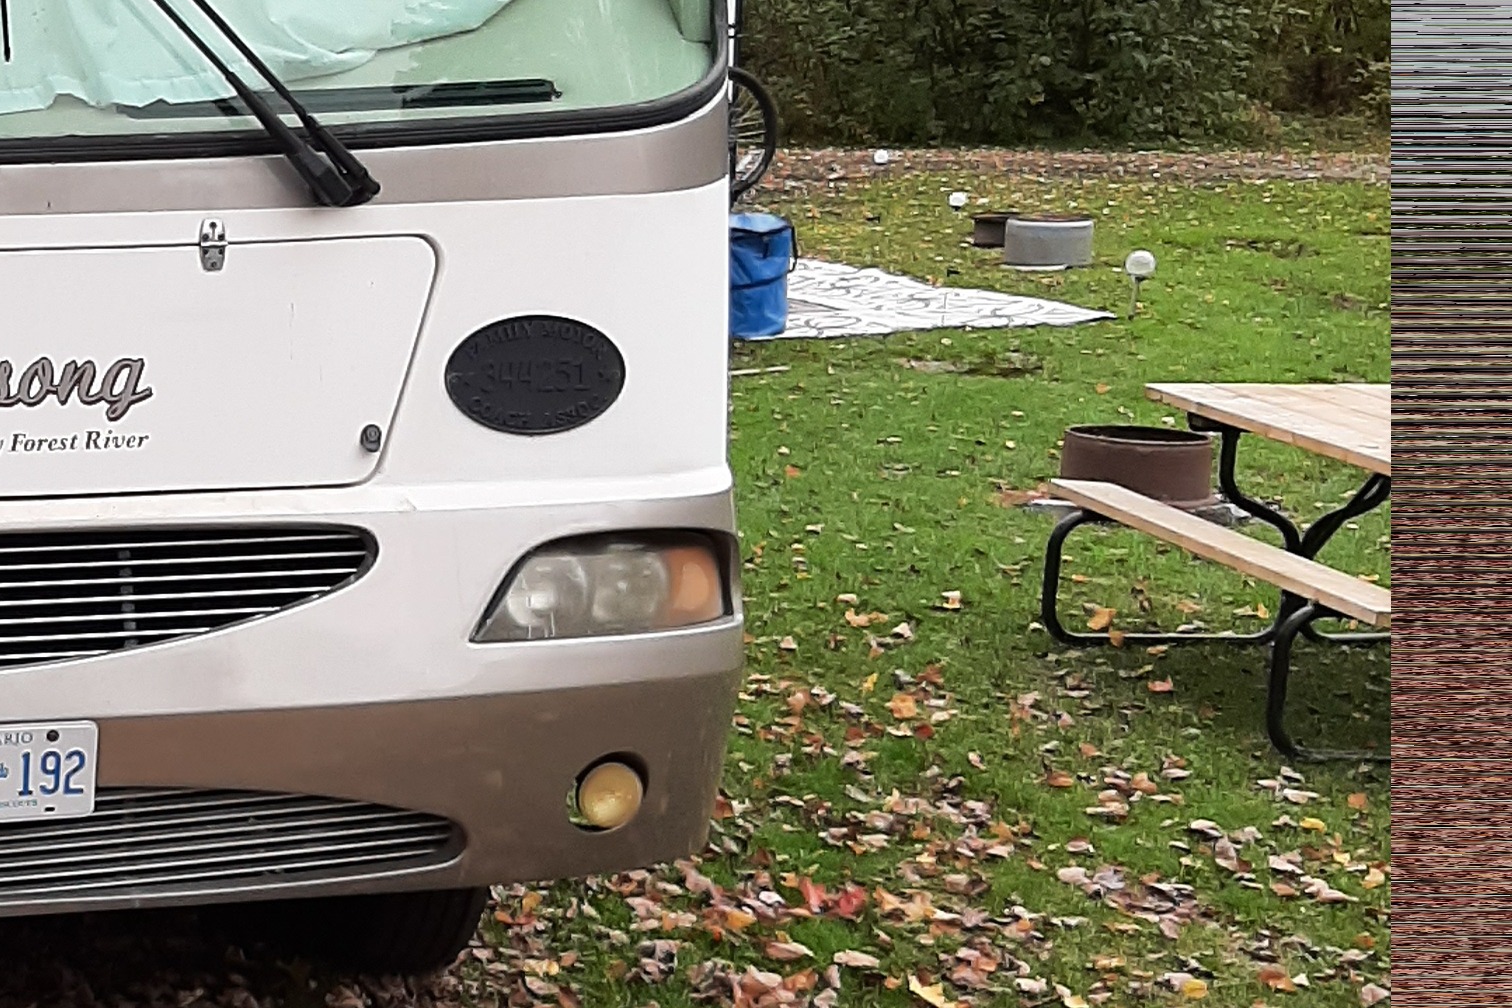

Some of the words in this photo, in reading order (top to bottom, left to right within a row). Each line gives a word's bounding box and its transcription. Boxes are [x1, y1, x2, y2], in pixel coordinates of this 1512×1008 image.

[8, 432, 78, 452] Forest
[85, 429, 150, 451] River
[17, 750, 86, 797] 192
